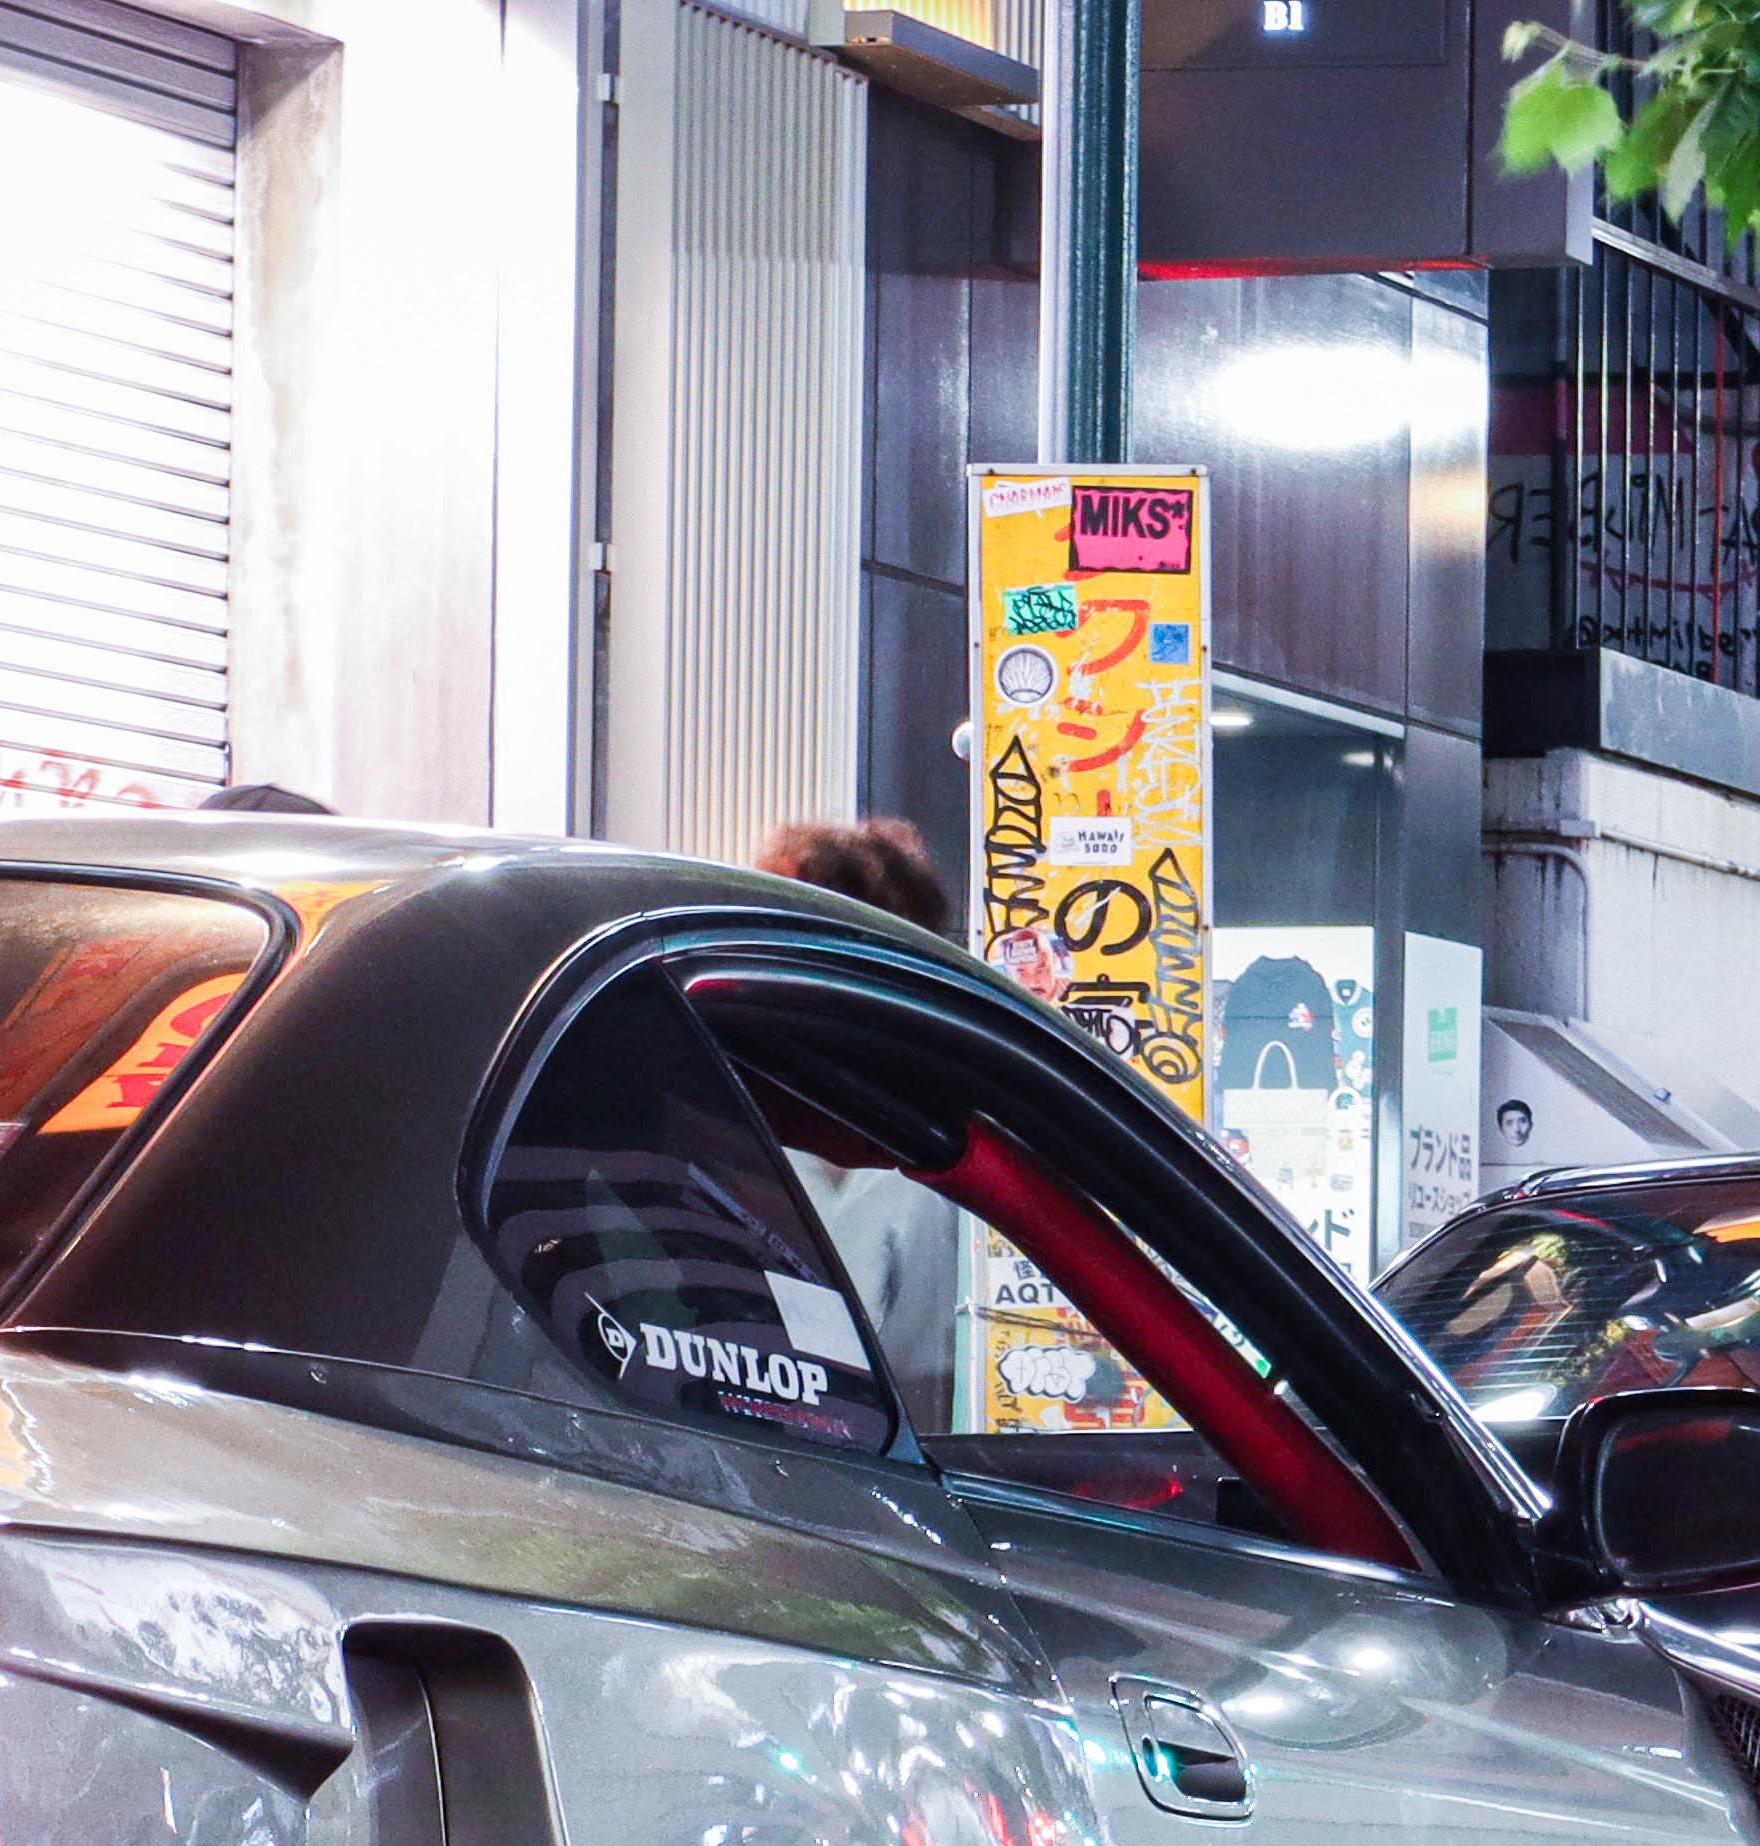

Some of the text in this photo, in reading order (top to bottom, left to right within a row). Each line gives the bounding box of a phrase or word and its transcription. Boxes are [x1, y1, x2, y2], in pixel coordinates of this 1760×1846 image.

[1408, 1125, 1473, 1182] ブランド品
[639, 1322, 828, 1406] DUNLOP
